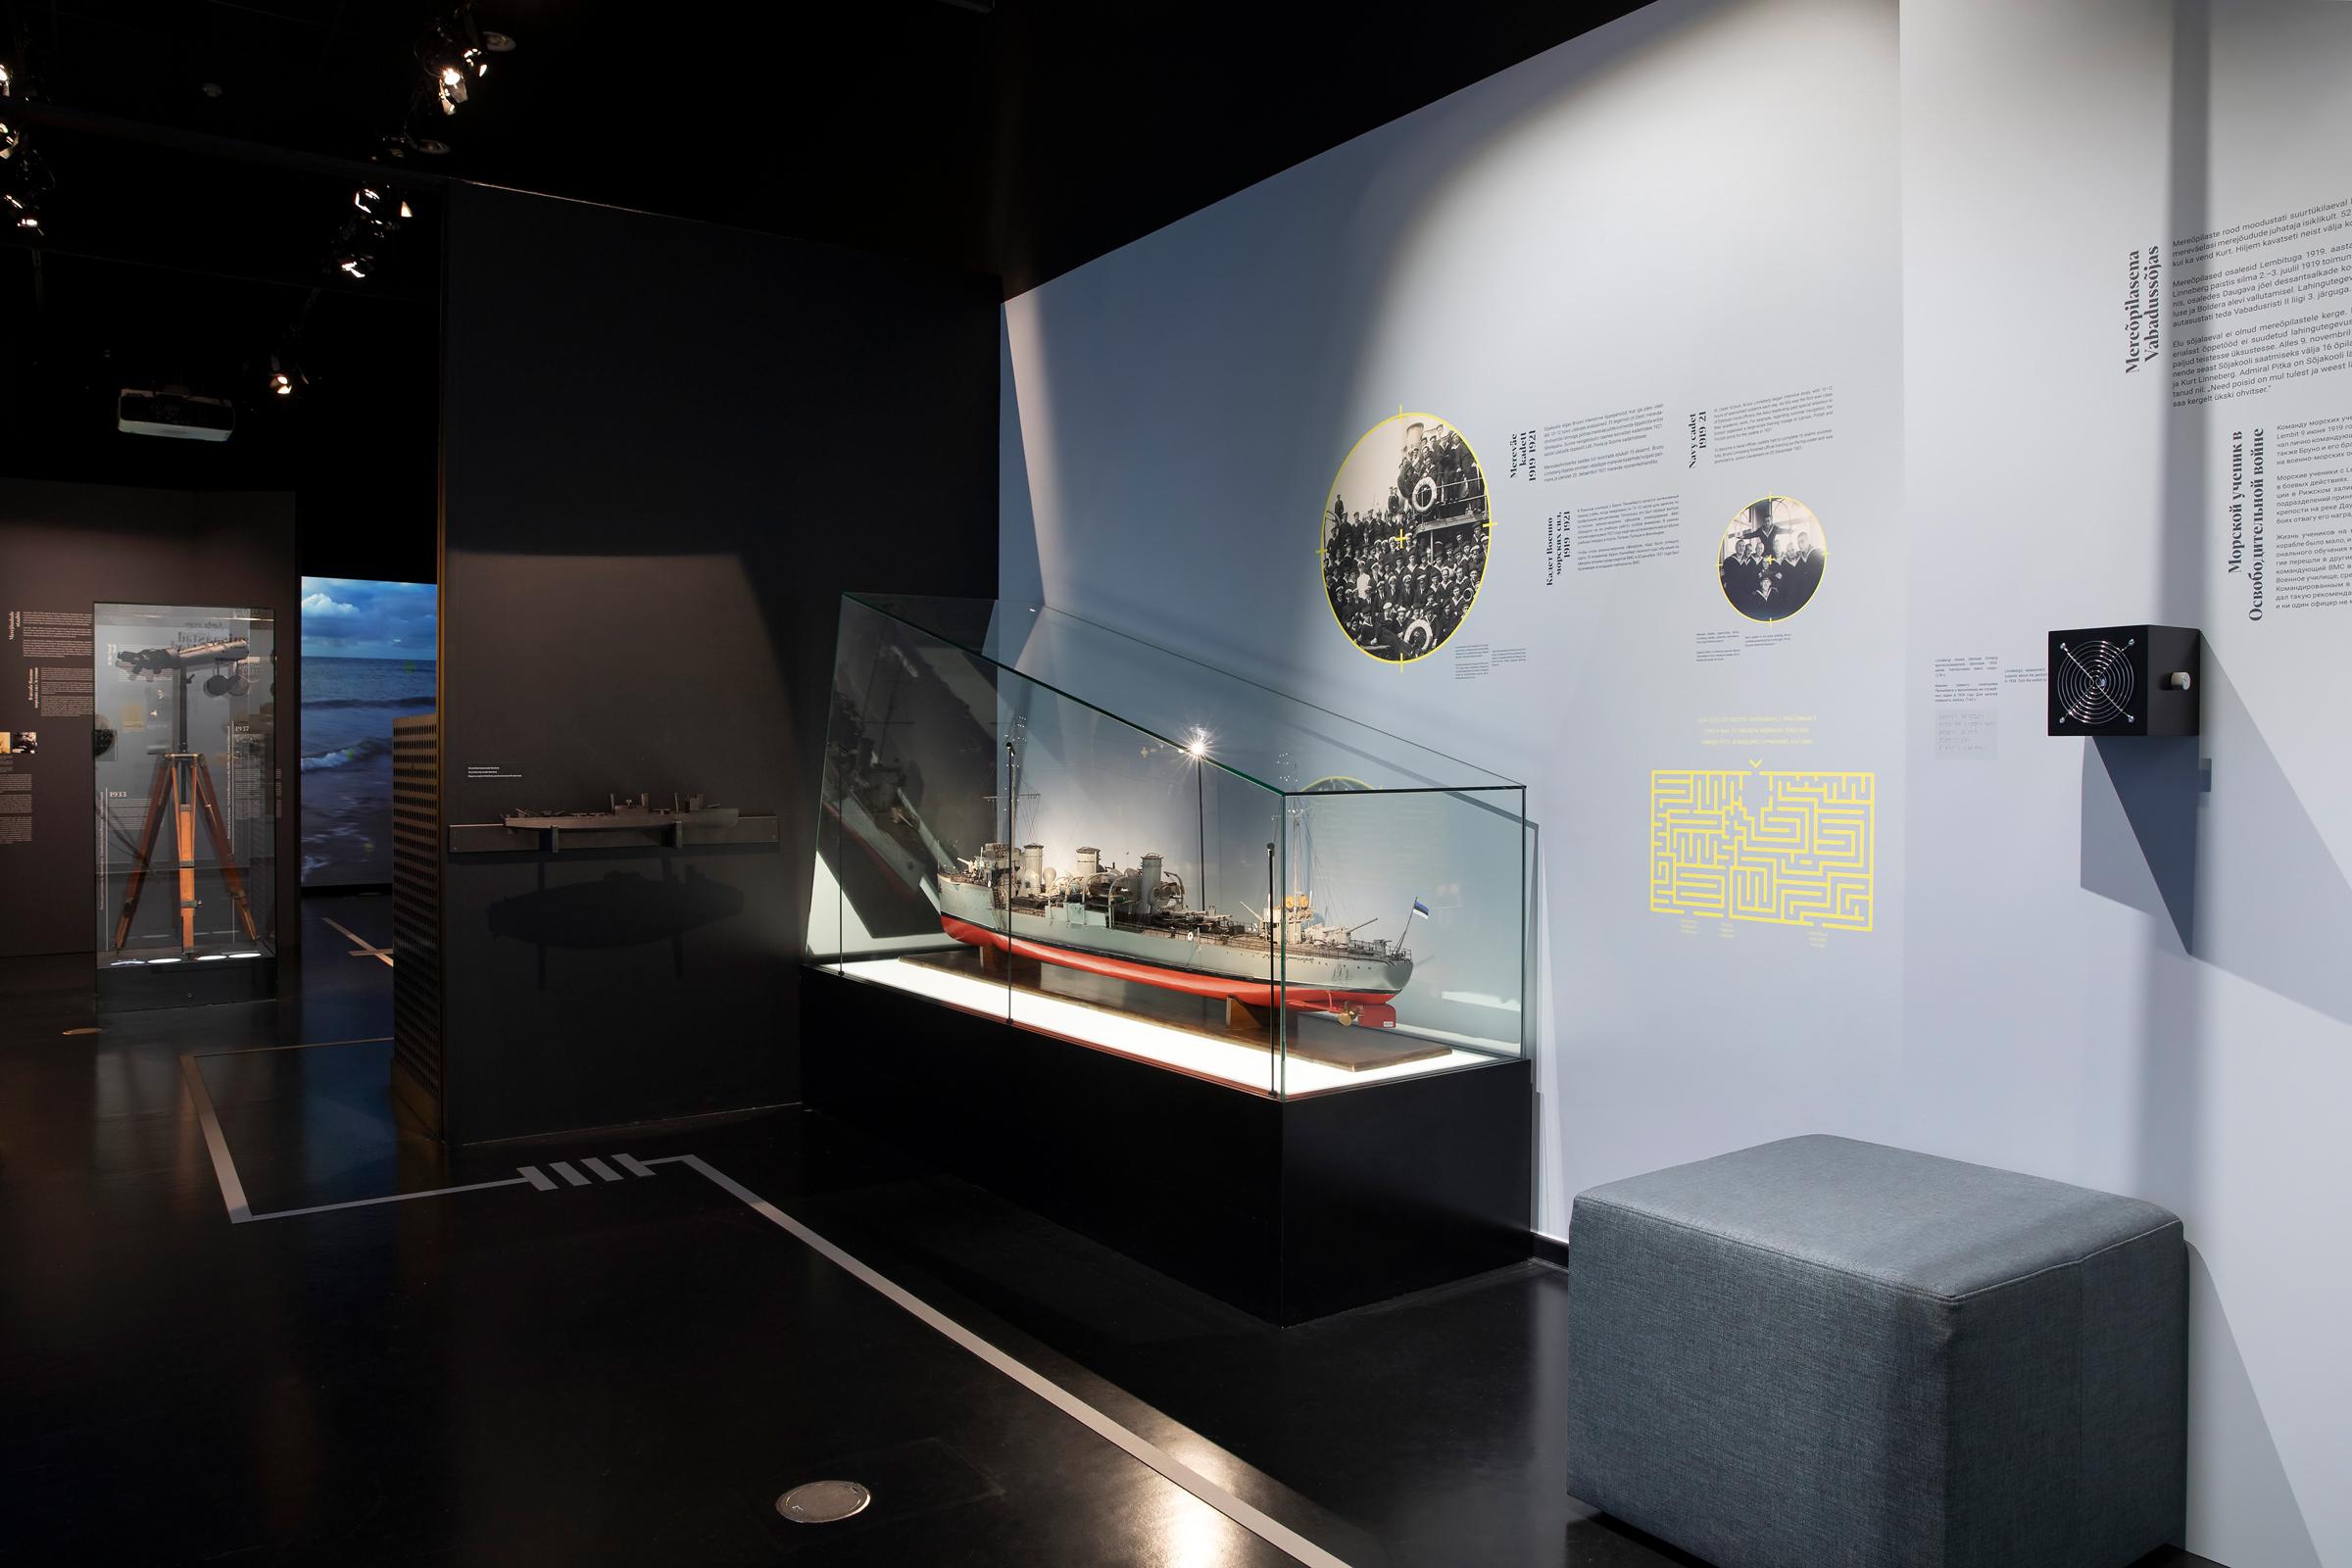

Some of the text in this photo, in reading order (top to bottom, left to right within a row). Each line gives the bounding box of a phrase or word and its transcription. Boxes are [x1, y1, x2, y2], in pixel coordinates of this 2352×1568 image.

[2173, 198, 2348, 248] Mereõpilaste rood moodustati suurtükilaeval
[2218, 229, 2268, 247] merejõudude
[2269, 221, 2301, 237] juhataja
[2173, 258, 2183, 268] kui
[2195, 251, 2213, 263] vend
[2235, 242, 2260, 253] Hiljem
[2263, 230, 2298, 247] kavatseti
[2301, 226, 2321, 237] neist
[2323, 222, 2342, 232] välja
[2173, 247, 2327, 288] Mereõpilased osalesid Lembituga 1919.
[2173, 285, 2209, 298] Linneberg
[2211, 278, 2234, 292] paistis
[2236, 274, 2257, 284] silma
[2280, 263, 2299, 276] juulil
[2302, 259, 2321, 270] 1919
[2187, 292, 2220, 305] osaledes
[2223, 286, 2256, 297] Daugava
[2258, 277, 2272, 292] jõel
[2275, 267, 2338, 284] dessantsalkade
[2125, 251, 2142, 373] Mereõpilasena
[2143, 245, 2163, 363] Vabadussõjas
[2173, 313, 2213, 327] autasustati
[2215, 310, 2232, 319] teda
[2234, 299, 2281, 316] Vabadusristi
[2292, 294, 2305, 304] liigi
[2197, 302, 2226, 313] Boldera
[2228, 297, 2245, 307] alevi
[2186, 331, 2223, 346] sõjalaeval
[2235, 325, 2257, 336] olnud
[2260, 315, 2319, 332] mereõpilastele
[2322, 311, 2347, 319] kerge.
[2196, 353, 2230, 364] teistesse
[2279, 340, 2299, 349] Alles
[2310, 328, 2351, 343] novembril
[2251, 330, 2287, 344] suudetud
[2173, 367, 2195, 377] nende
[2196, 363, 2217, 372] seast
[2219, 357, 2253, 369] Sõjakooli
[2254, 349, 2299, 364] saatmiseks
[2301, 346, 2321, 355] välja
[2173, 387, 2193, 397] tanud
[2232, 377, 2255, 390] poisid
[2270, 371, 2284, 382] mul
[2286, 368, 2309, 378] tulest
[2321, 362, 2346, 373] weest
[2181, 376, 2196, 386] Kurt
[2198, 372, 2236, 383] Linneberg.
[2239, 364, 2270, 376] Admiral
[2272, 361, 2291, 370] Pitka
[2307, 352, 2344, 366] Sõjakooli
[2187, 392, 2213, 405] kergelt
[1688, 414, 1697, 468] Navy cadet
[2229, 431, 2245, 573] Морской ученик в
[2248, 428, 2265, 621] Освободительной войне
